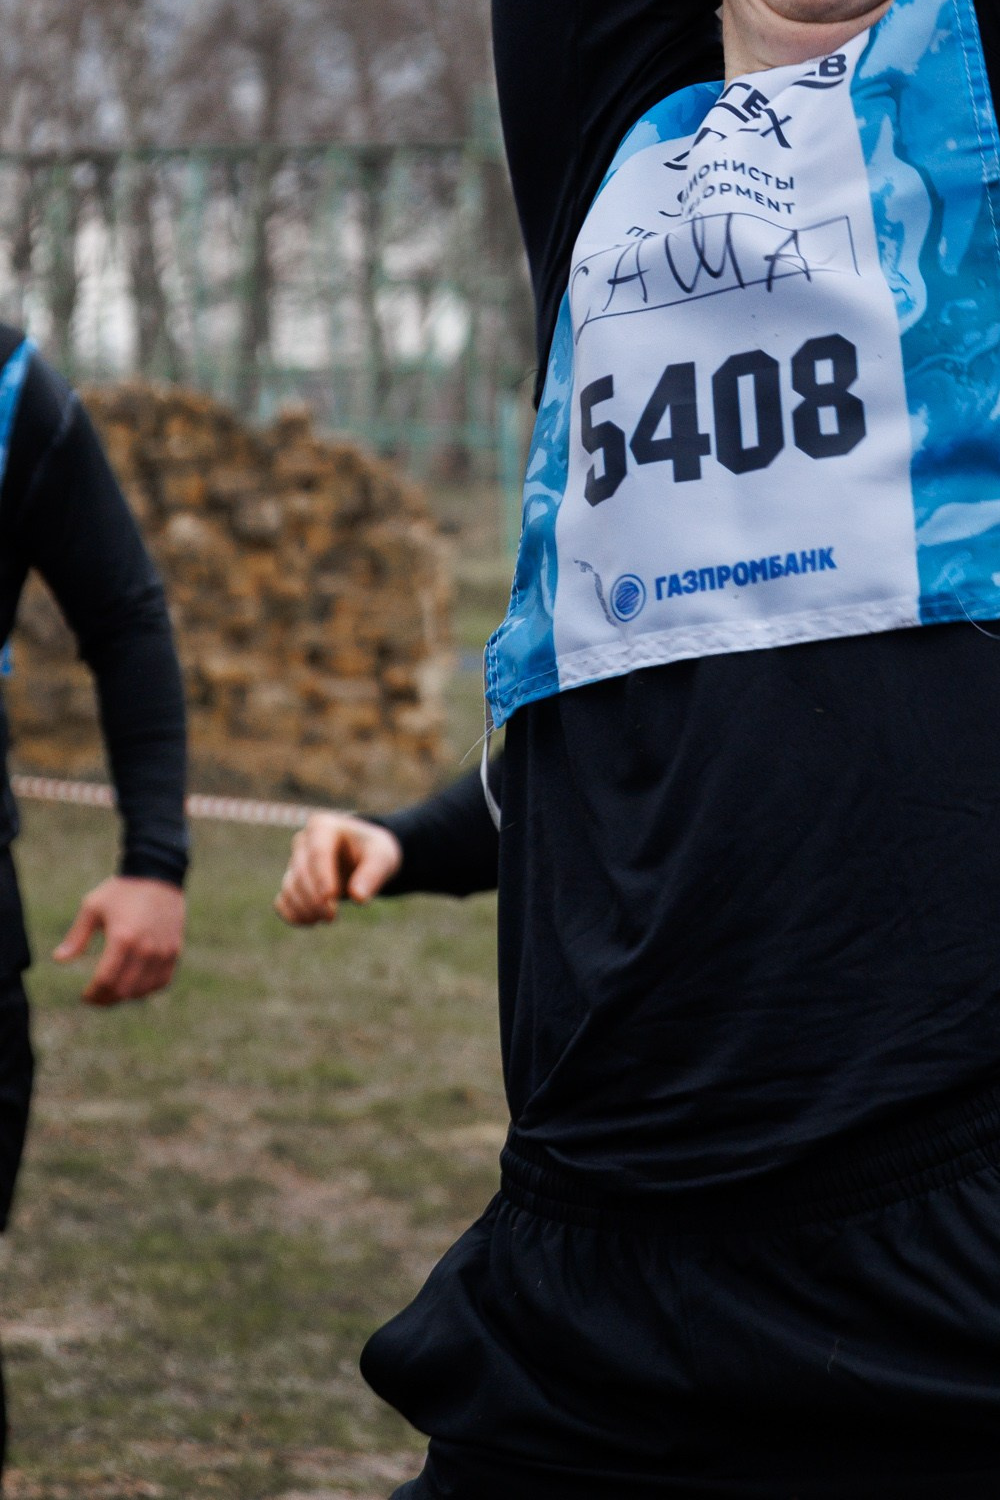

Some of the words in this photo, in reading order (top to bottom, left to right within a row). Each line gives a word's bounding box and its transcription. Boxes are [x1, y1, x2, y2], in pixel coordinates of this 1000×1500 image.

[684, 158, 795, 201] ИОНИСТЫ
[690, 182, 796, 215] OPMENT
[579, 333, 866, 507] 5408
[655, 547, 837, 600] ГАЗПРОМБАНК
